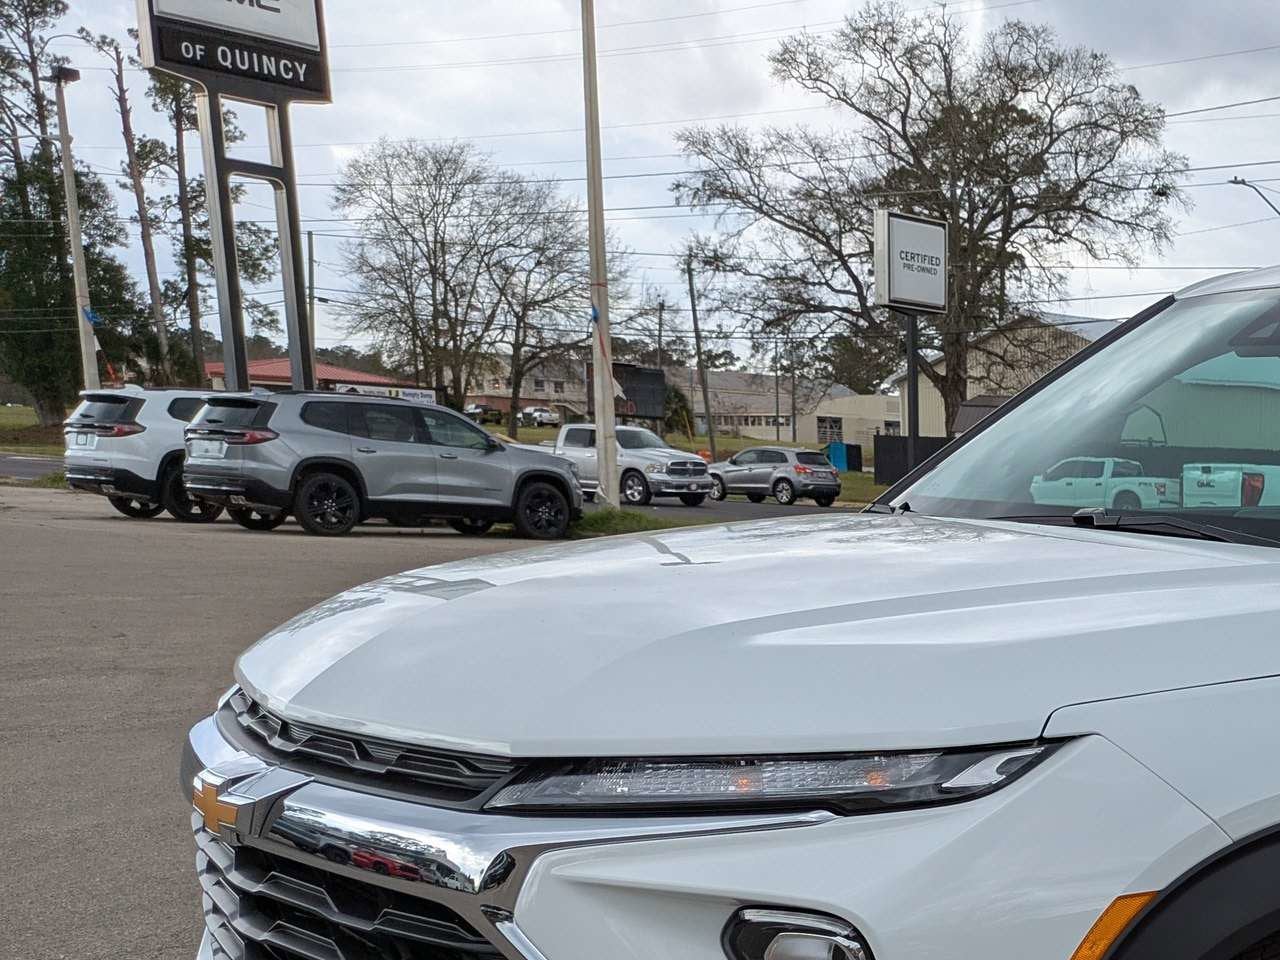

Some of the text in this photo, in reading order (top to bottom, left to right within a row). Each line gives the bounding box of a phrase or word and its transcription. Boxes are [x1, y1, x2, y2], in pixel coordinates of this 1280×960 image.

[181, 41, 307, 82] OF QUINCY
[900, 250, 941, 267] CERTIFIED
[903, 263, 938, 276] PRE-OWNED
